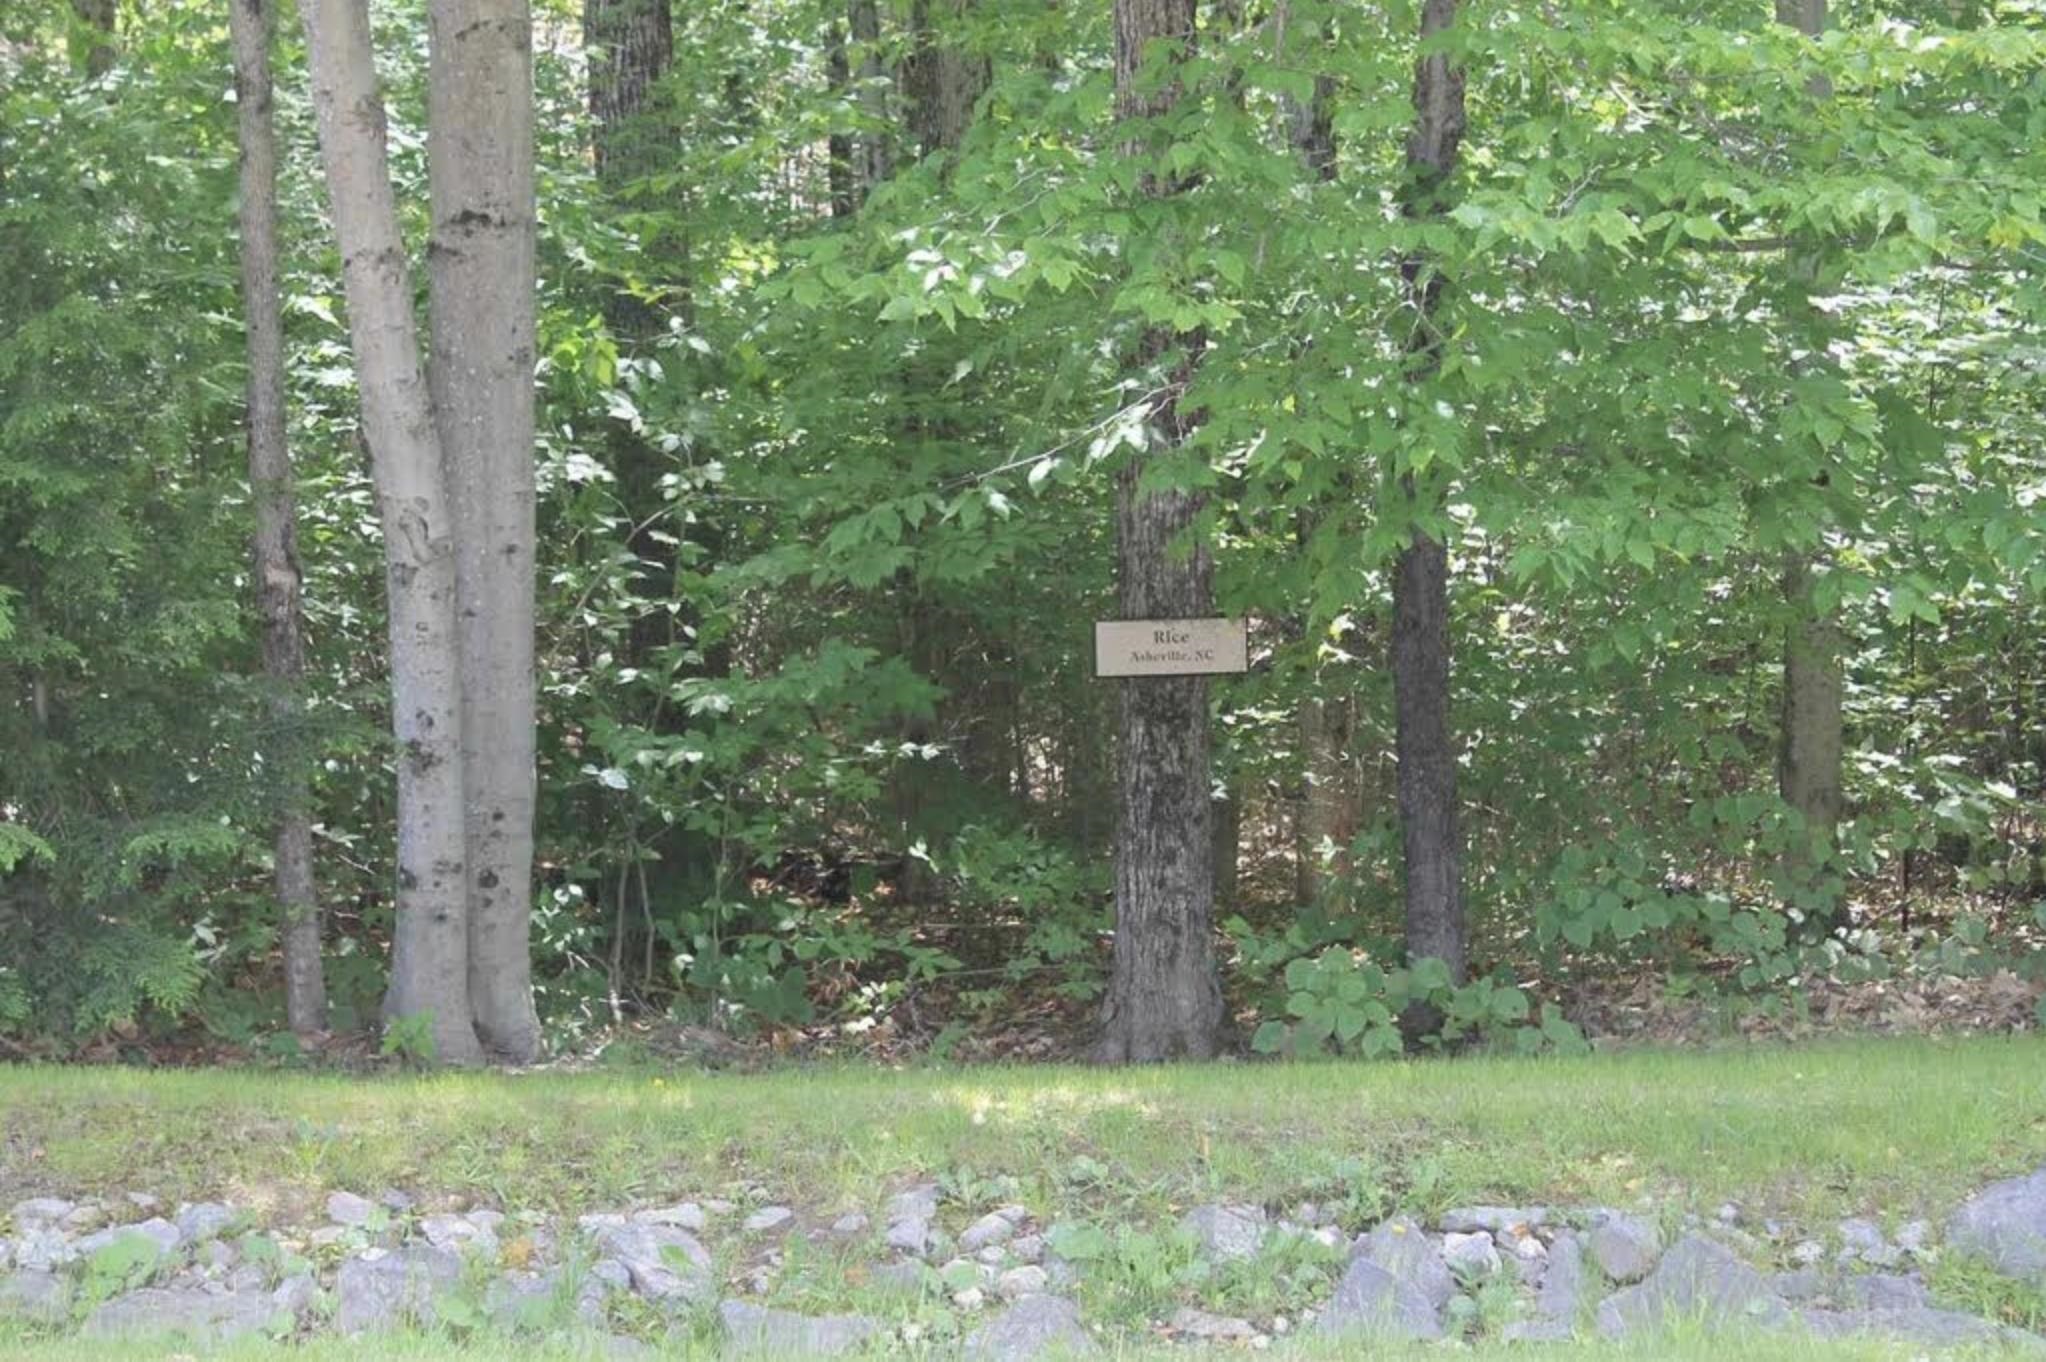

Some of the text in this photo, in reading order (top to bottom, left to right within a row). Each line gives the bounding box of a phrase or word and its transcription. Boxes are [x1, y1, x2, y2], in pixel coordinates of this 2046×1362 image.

[1153, 628, 1190, 644] Rice
[1130, 649, 1214, 663] Asheville, NC
